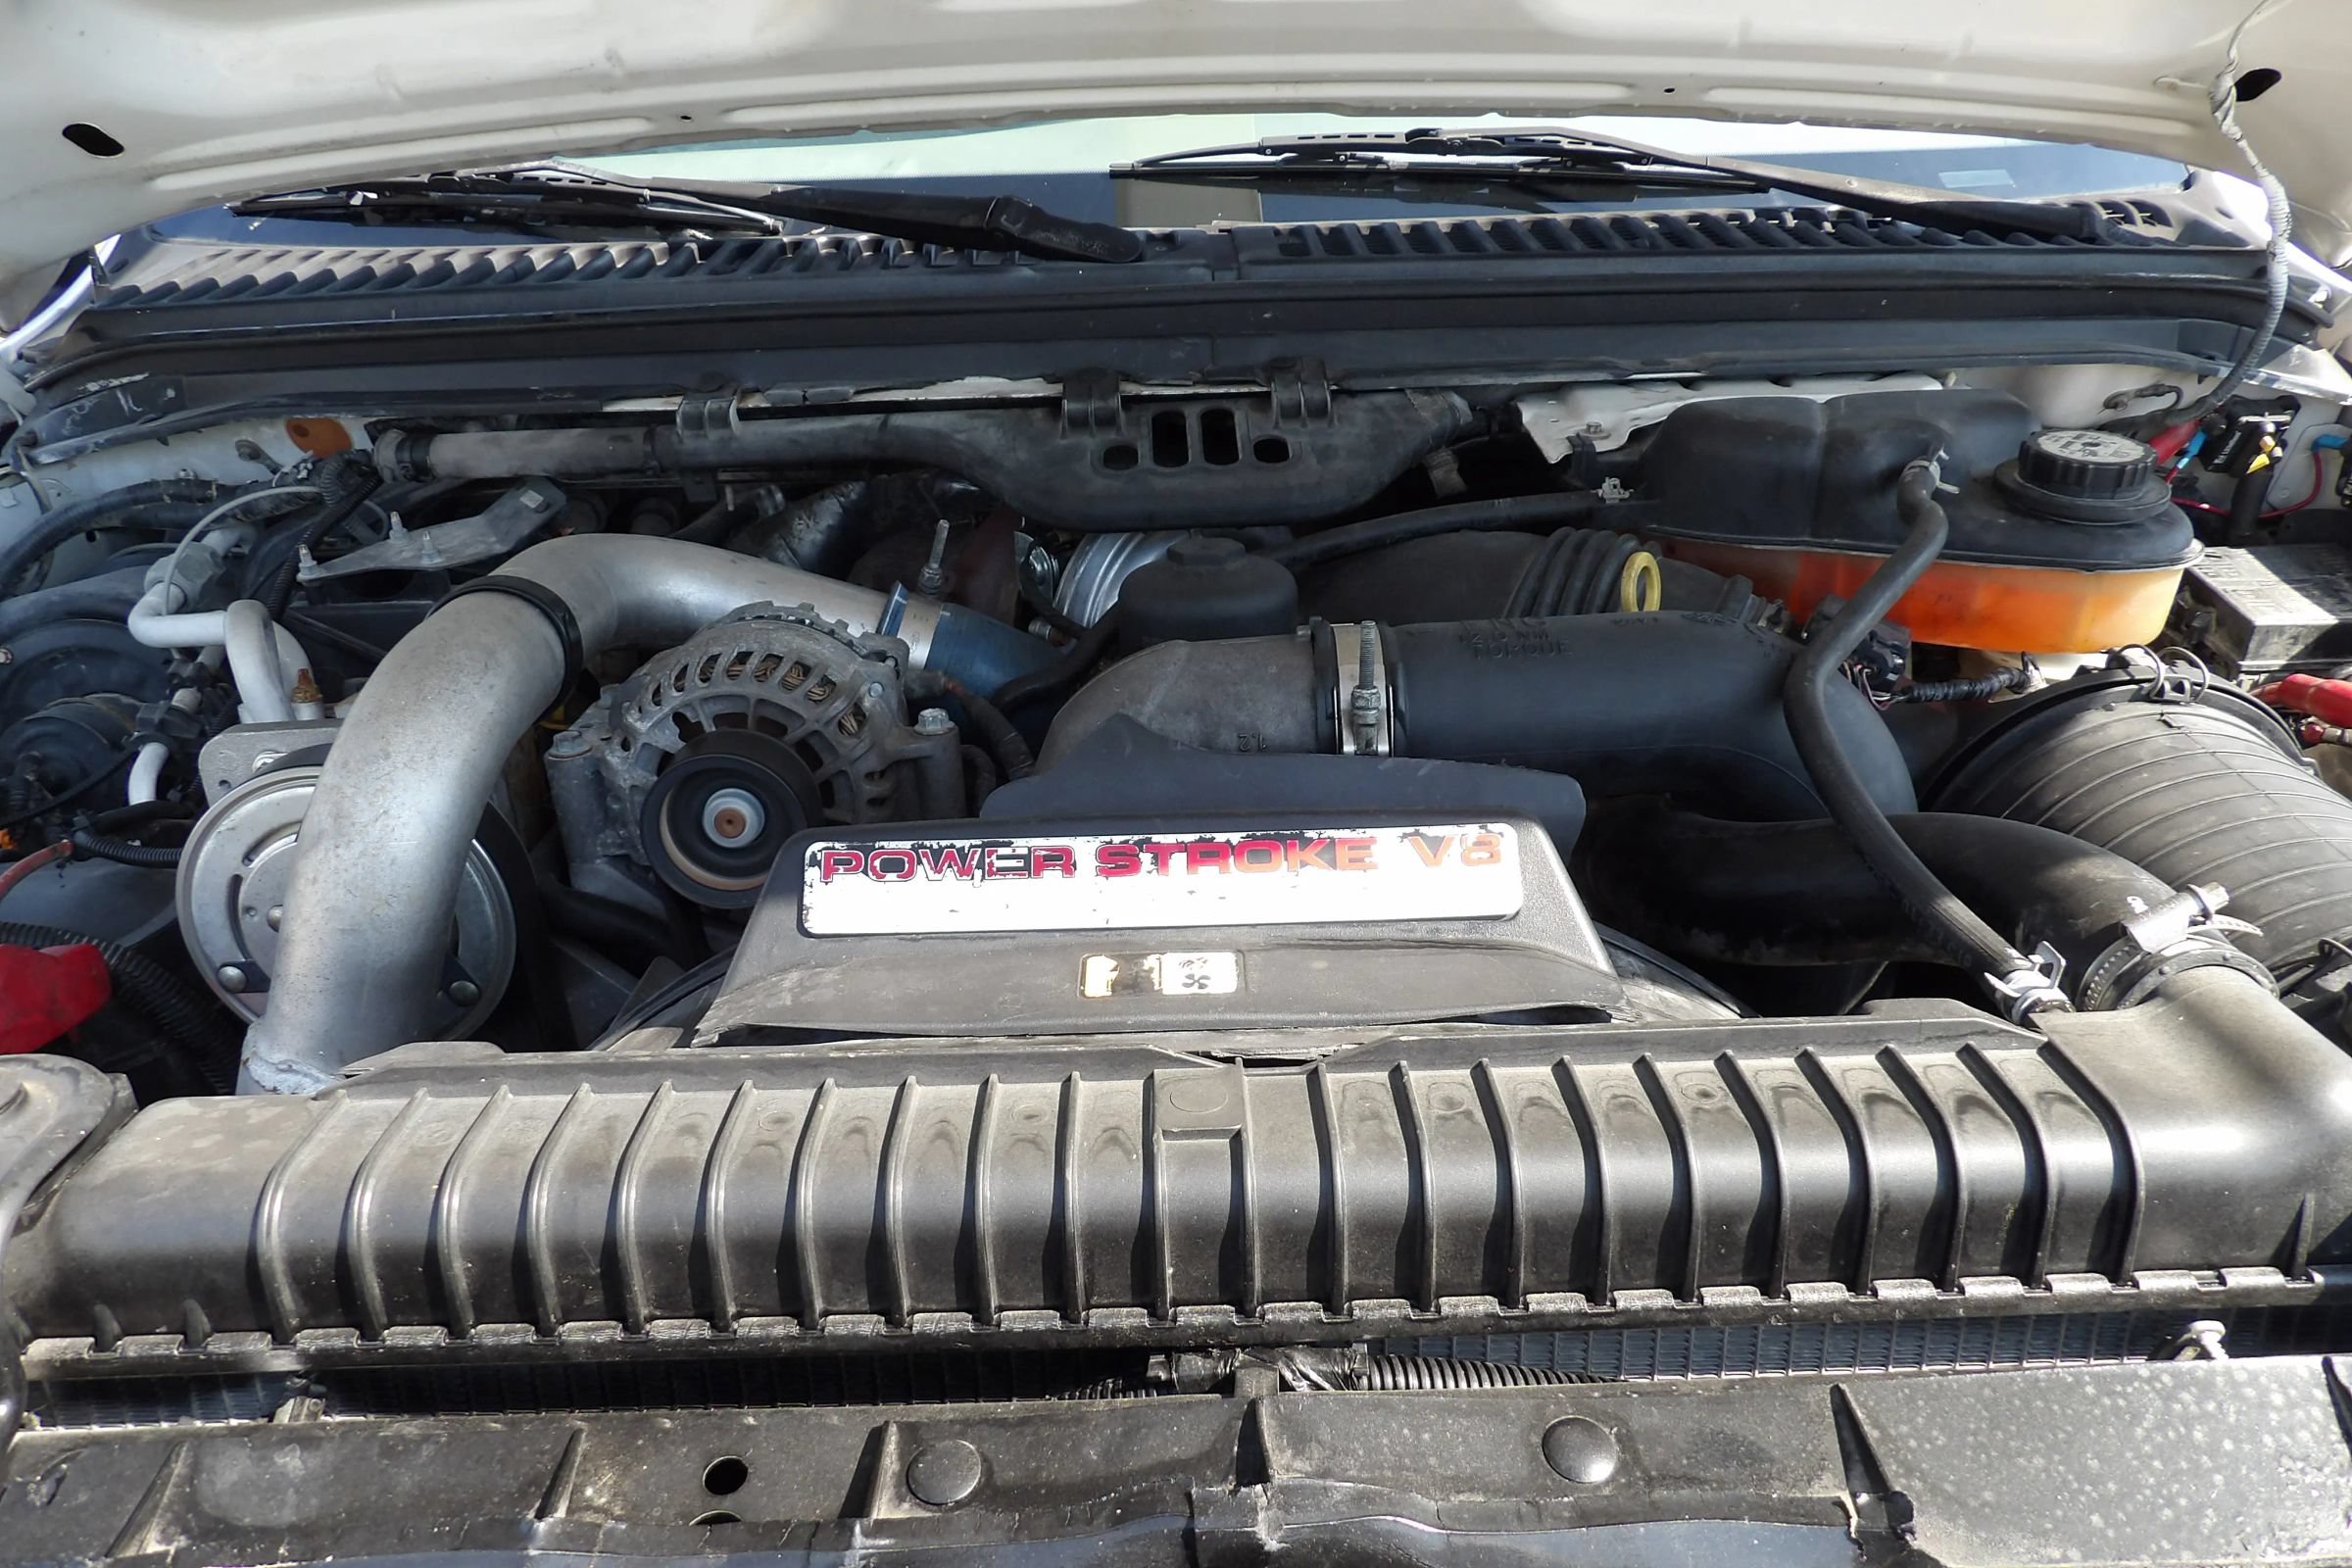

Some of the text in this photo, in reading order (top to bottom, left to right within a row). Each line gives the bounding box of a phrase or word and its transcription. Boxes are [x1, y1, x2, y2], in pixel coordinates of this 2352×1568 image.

[1473, 637, 1574, 660] TORQUE
[820, 832, 1503, 884] POWER STROKE V8
